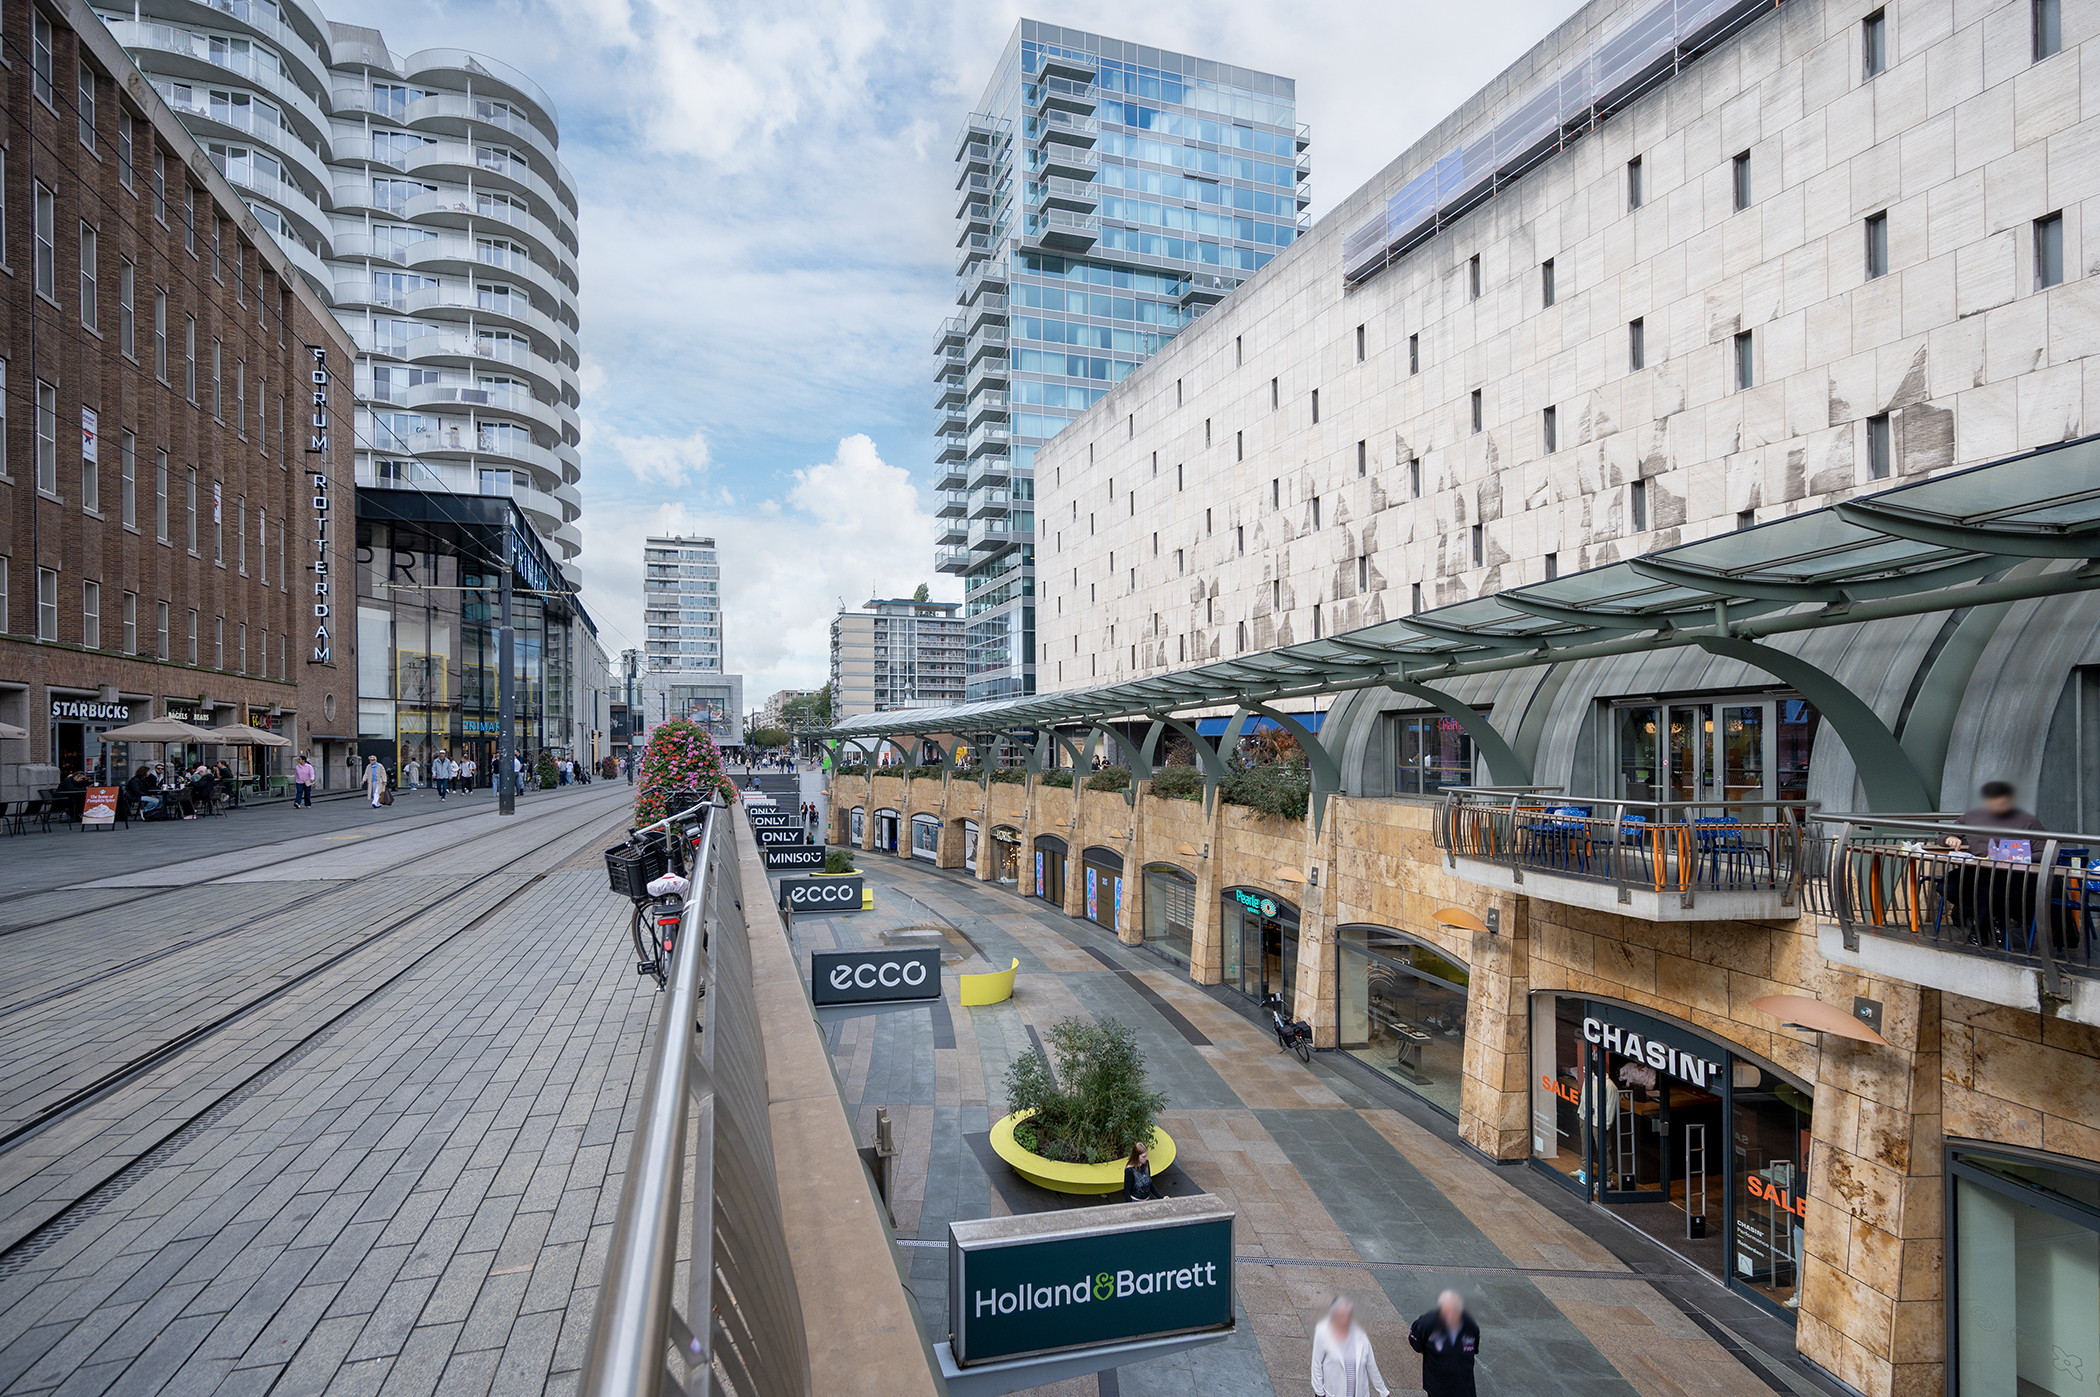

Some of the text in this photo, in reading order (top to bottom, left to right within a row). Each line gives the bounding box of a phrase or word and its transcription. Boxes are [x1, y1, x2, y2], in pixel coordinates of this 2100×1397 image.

[312, 349, 328, 450] FORUM
[313, 475, 330, 660] ROTTERDAM
[52, 701, 129, 719] STARBUCKS
[168, 711, 188, 720] BAGELS
[194, 713, 209, 721] BEANS
[463, 721, 500, 732] PRIMAR
[755, 817, 786, 825] ONLY
[762, 832, 799, 842] ONLY
[769, 853, 811, 864] MINISO
[791, 885, 854, 903] ecco
[1235, 889, 1261, 909] Pearle
[830, 961, 927, 990] ecco
[1583, 1017, 1717, 1088] CHASIN'
[1541, 1075, 1579, 1106] SALE
[1747, 1175, 1807, 1219] SALE
